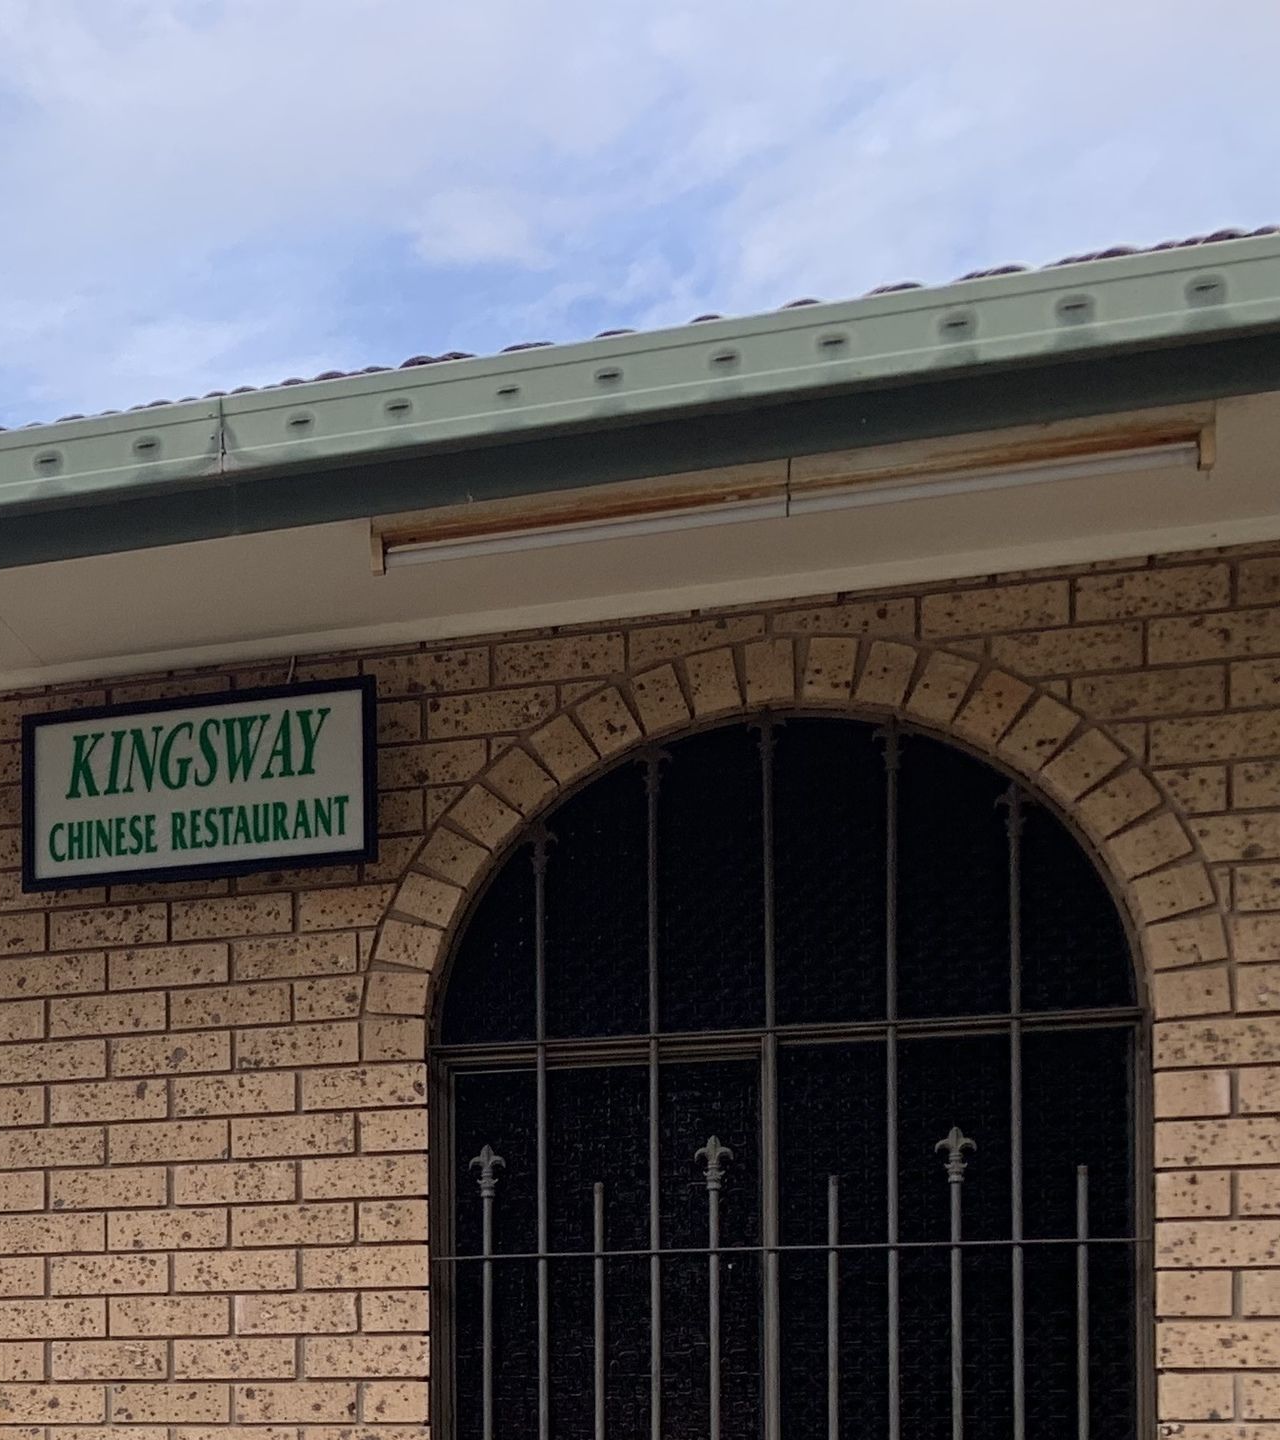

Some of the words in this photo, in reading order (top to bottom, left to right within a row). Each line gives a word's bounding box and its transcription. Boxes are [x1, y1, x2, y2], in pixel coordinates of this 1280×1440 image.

[65, 707, 331, 799] KINGSWAY
[49, 814, 157, 862] CHINESE
[171, 795, 349, 850] RESTAURANT
